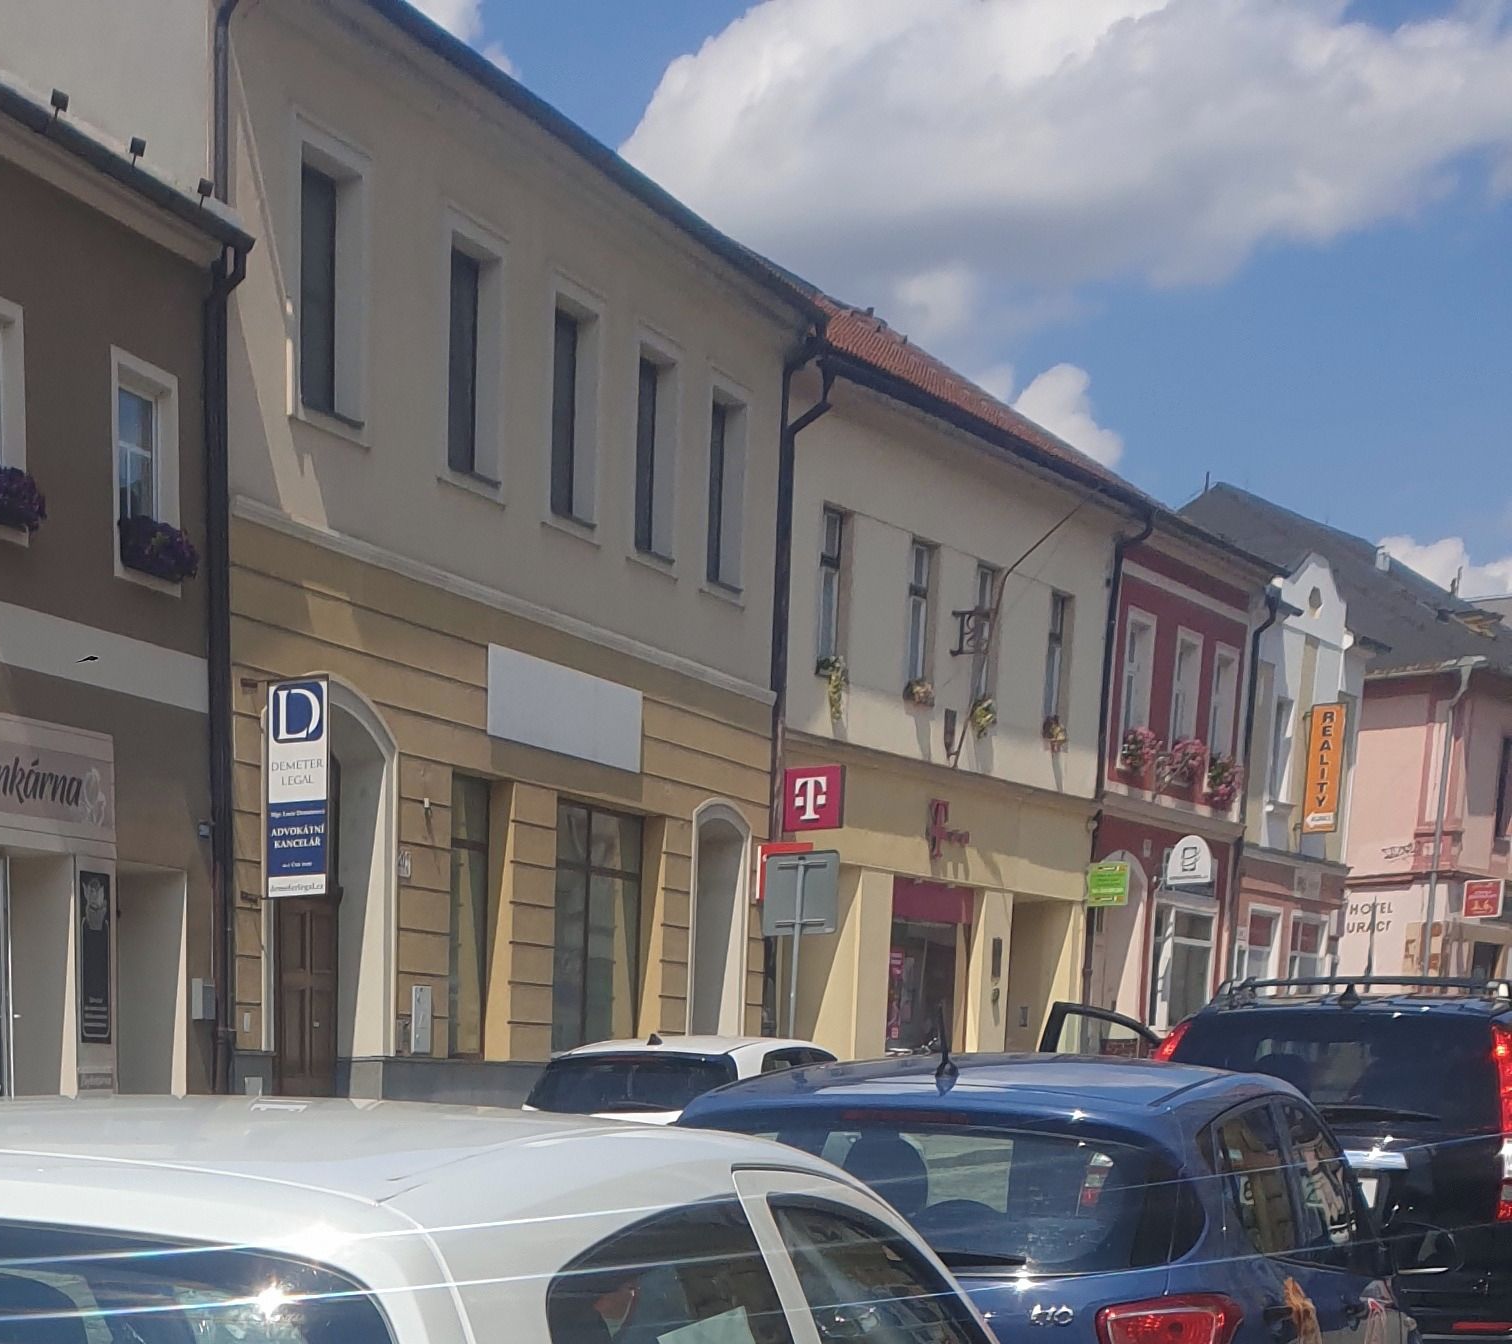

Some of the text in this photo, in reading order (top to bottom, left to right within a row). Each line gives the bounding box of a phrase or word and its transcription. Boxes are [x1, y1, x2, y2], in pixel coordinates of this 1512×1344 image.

[271, 758, 324, 772] DEMETER
[1316, 710, 1335, 809] REALITY
[281, 774, 315, 786] LEGAL
[271, 823, 325, 838] ADVOKÁTNÍ
[274, 836, 321, 849] KANCELÁŘ
